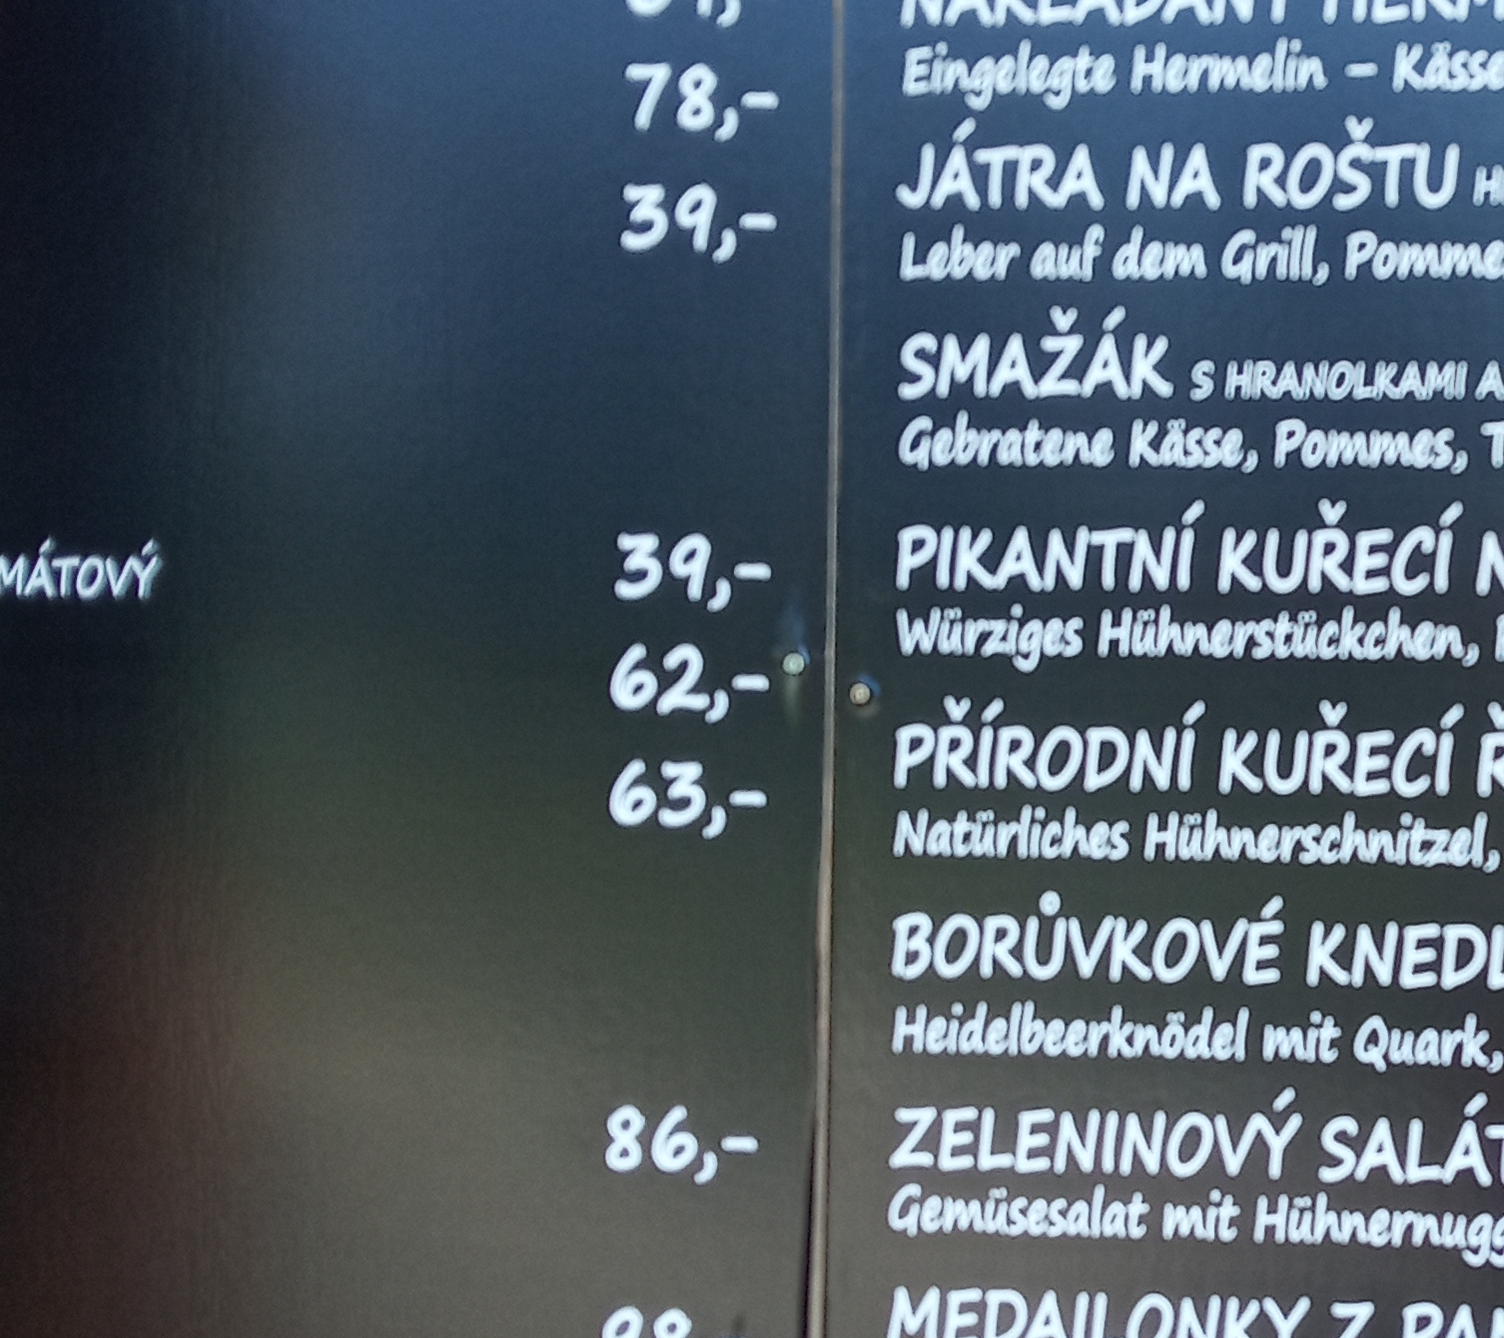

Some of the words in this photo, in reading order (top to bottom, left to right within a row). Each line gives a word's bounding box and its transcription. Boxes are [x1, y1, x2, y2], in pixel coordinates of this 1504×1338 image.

[625, 62, 779, 142] 78,-
[901, 39, 1117, 112] Eingelegte
[1129, 37, 1328, 94] Hermelin
[895, 117, 1105, 211] JÁTRA
[1125, 142, 1222, 211] NA
[1242, 115, 1461, 212] ROŠTU
[620, 183, 777, 263] 39,-
[899, 224, 1022, 282] Leber
[1029, 223, 1106, 282] auf
[1111, 225, 1208, 282] dem
[1220, 224, 1330, 286] Grill,
[897, 305, 1174, 401] SMAŽÁK
[1189, 359, 1216, 402] S
[1224, 359, 1469, 401] HRANOLKAMI
[898, 410, 1115, 470] Gebratene
[1128, 418, 1259, 473] Kässe,
[1273, 417, 1469, 475] Pommes,
[614, 533, 772, 612] 39,-
[895, 499, 1205, 593] PIKANTNÍ
[1217, 498, 1464, 597] KUŘECÍ
[896, 603, 1084, 673] Würziges
[1097, 604, 1480, 667] Hühnerstückchen,
[609, 643, 770, 723] 62,-
[893, 695, 1206, 793] PŘÍRODNÍ
[1218, 700, 1465, 799] KUŘECÍ
[609, 759, 767, 839] 63,-
[892, 804, 1130, 862] Natürliches
[1143, 808, 1501, 873] Hühnerschnitzel,
[890, 890, 1285, 986] BORŮVKOVÉ
[891, 1000, 1250, 1062] Heidelbeerknödel
[1261, 1010, 1342, 1064] mit
[1352, 1013, 1504, 1073] Quark,
[604, 1104, 759, 1185] 86,-
[888, 1087, 1303, 1180] ZELENINOVÝ
[887, 1182, 1151, 1240] Gemüsesalat
[1161, 1188, 1241, 1243] mit
